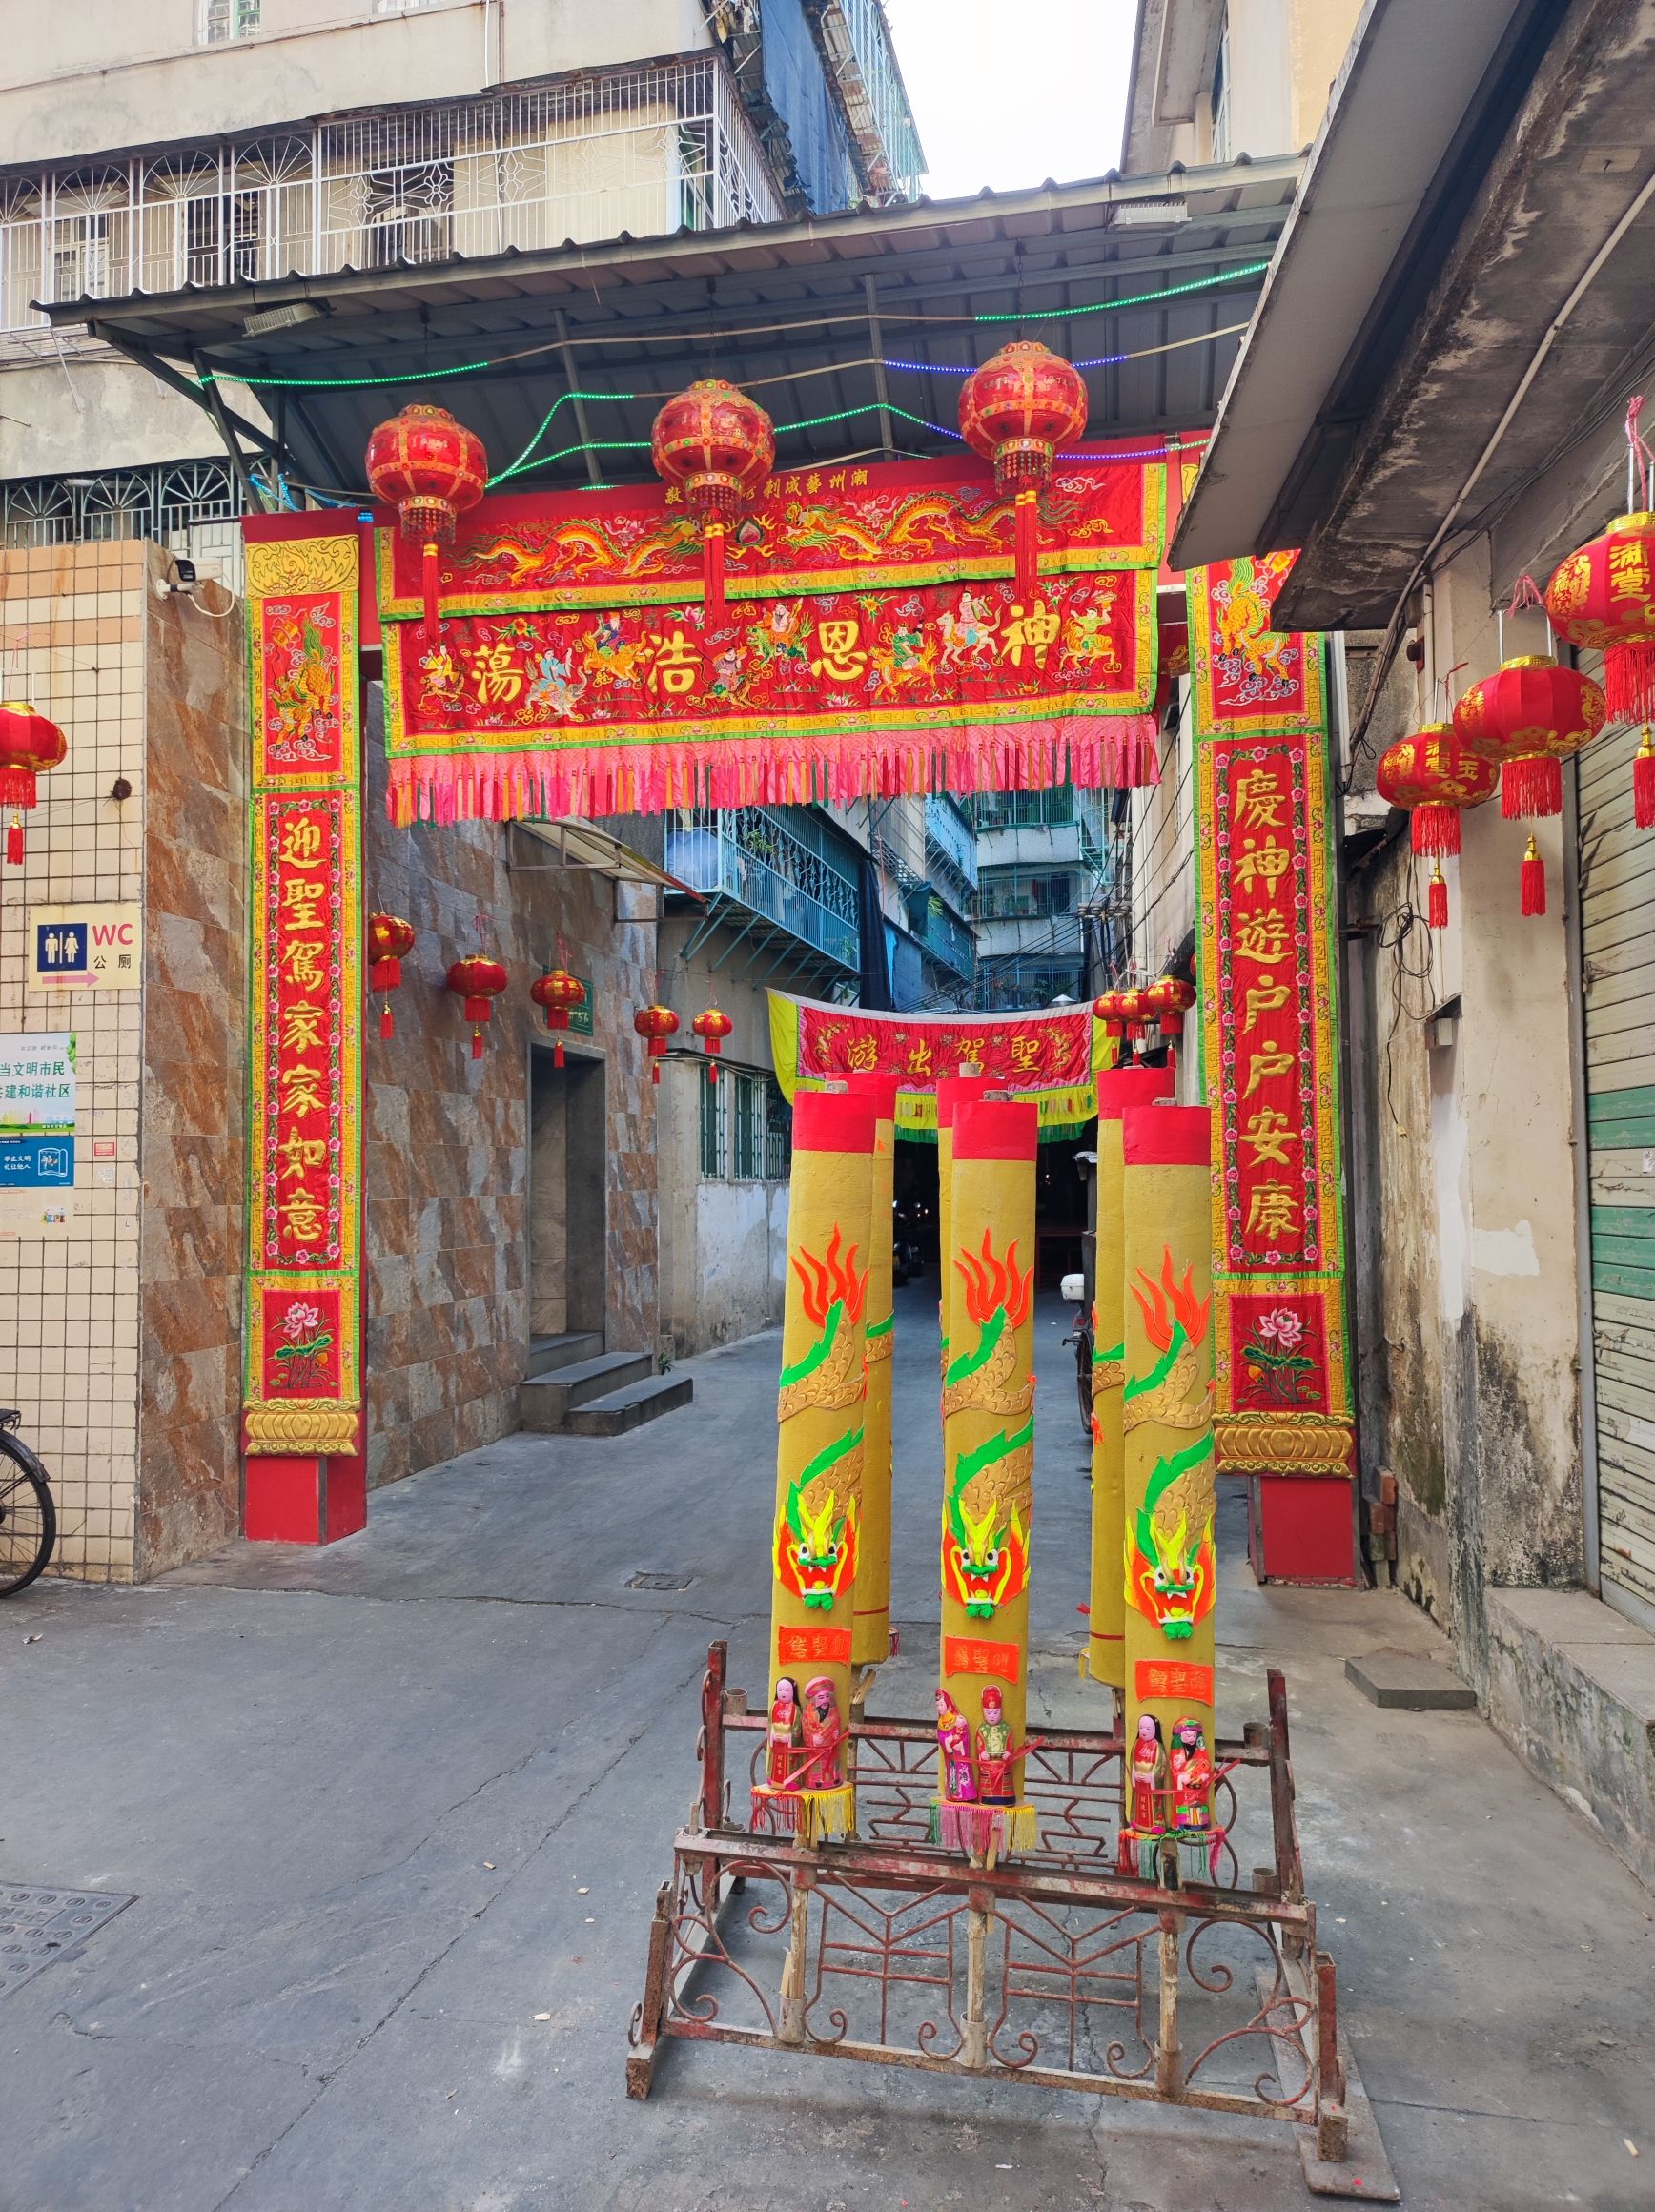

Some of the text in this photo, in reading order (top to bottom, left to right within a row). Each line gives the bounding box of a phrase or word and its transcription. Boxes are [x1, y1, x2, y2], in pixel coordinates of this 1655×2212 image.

[92, 922, 133, 946] WC
[93, 954, 132, 970] 公厕
[278, 821, 327, 1241] 迎聖駕家家如意
[0, 1060, 65, 1077] 当文明市民
